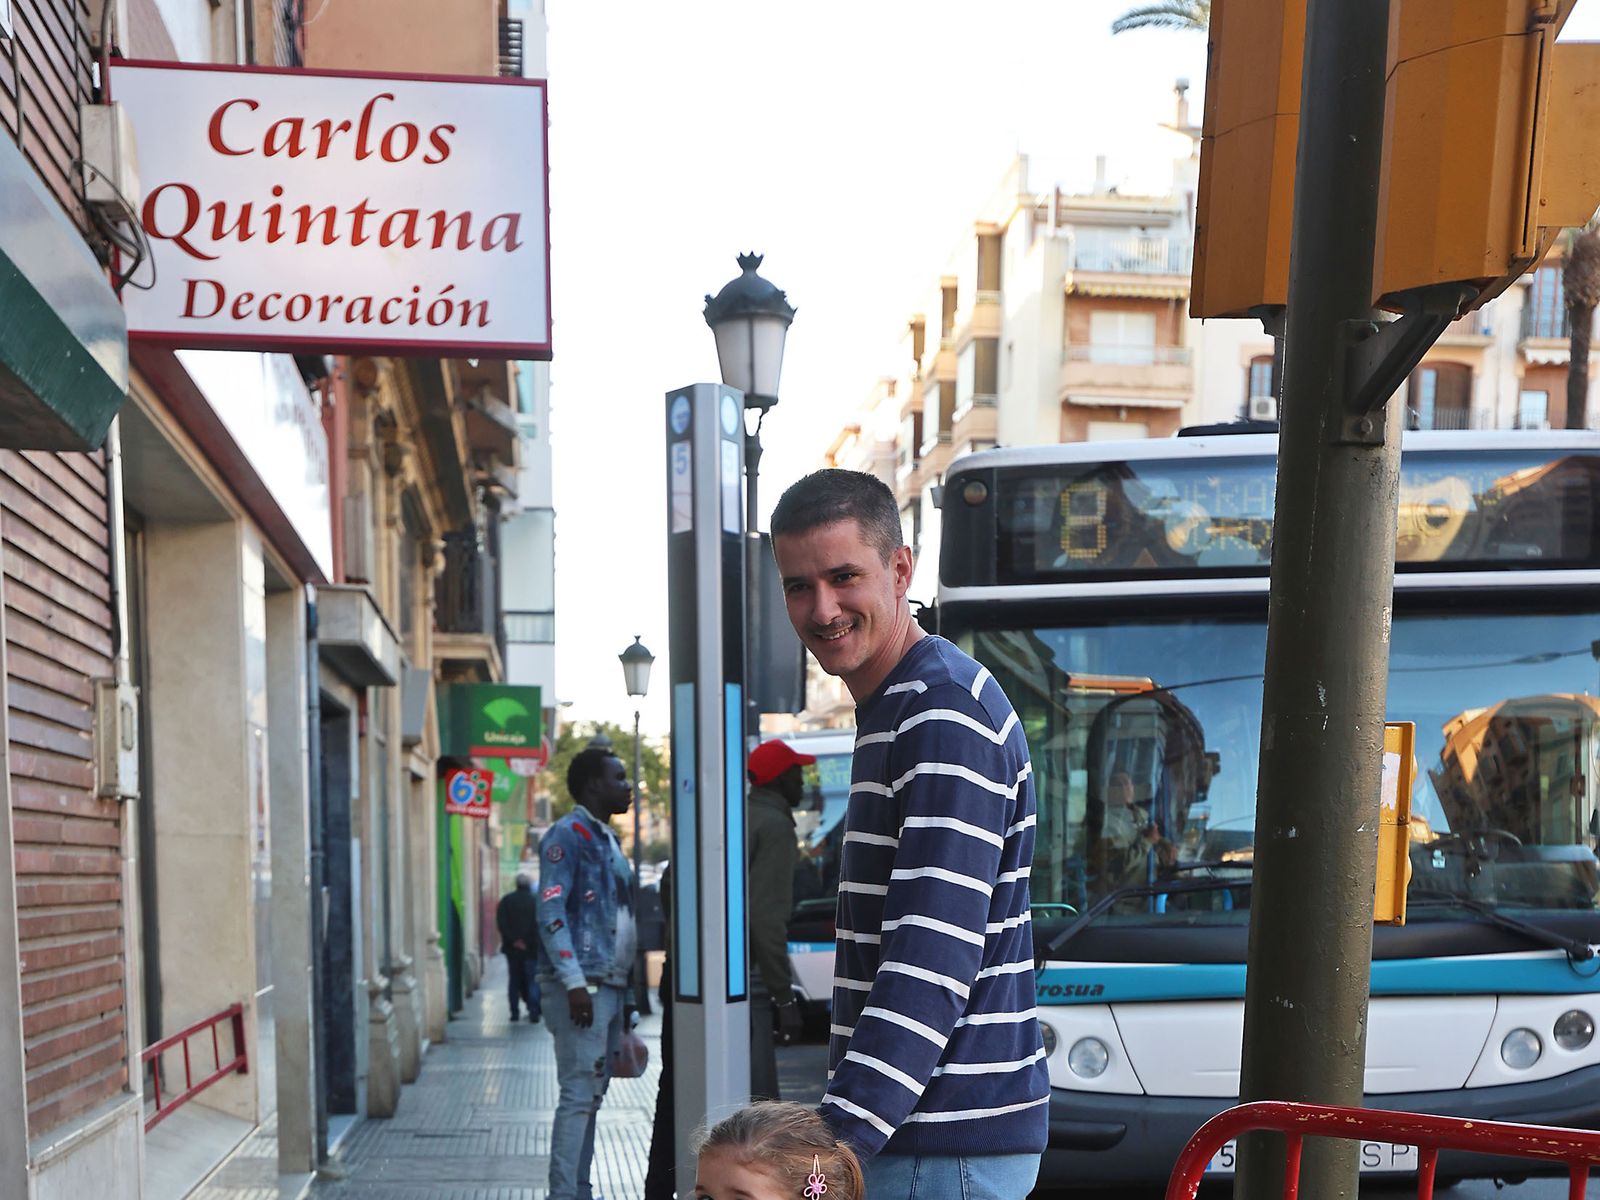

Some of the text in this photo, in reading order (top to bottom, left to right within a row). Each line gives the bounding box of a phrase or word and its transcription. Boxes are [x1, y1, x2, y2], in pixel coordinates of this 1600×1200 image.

[207, 93, 457, 164] Carlos
[141, 183, 524, 260] Quintana
[179, 279, 491, 328] Decoración
[674, 447, 688, 475] 5
[1060, 483, 1107, 559] 8
[1036, 982, 1106, 997] rosua
